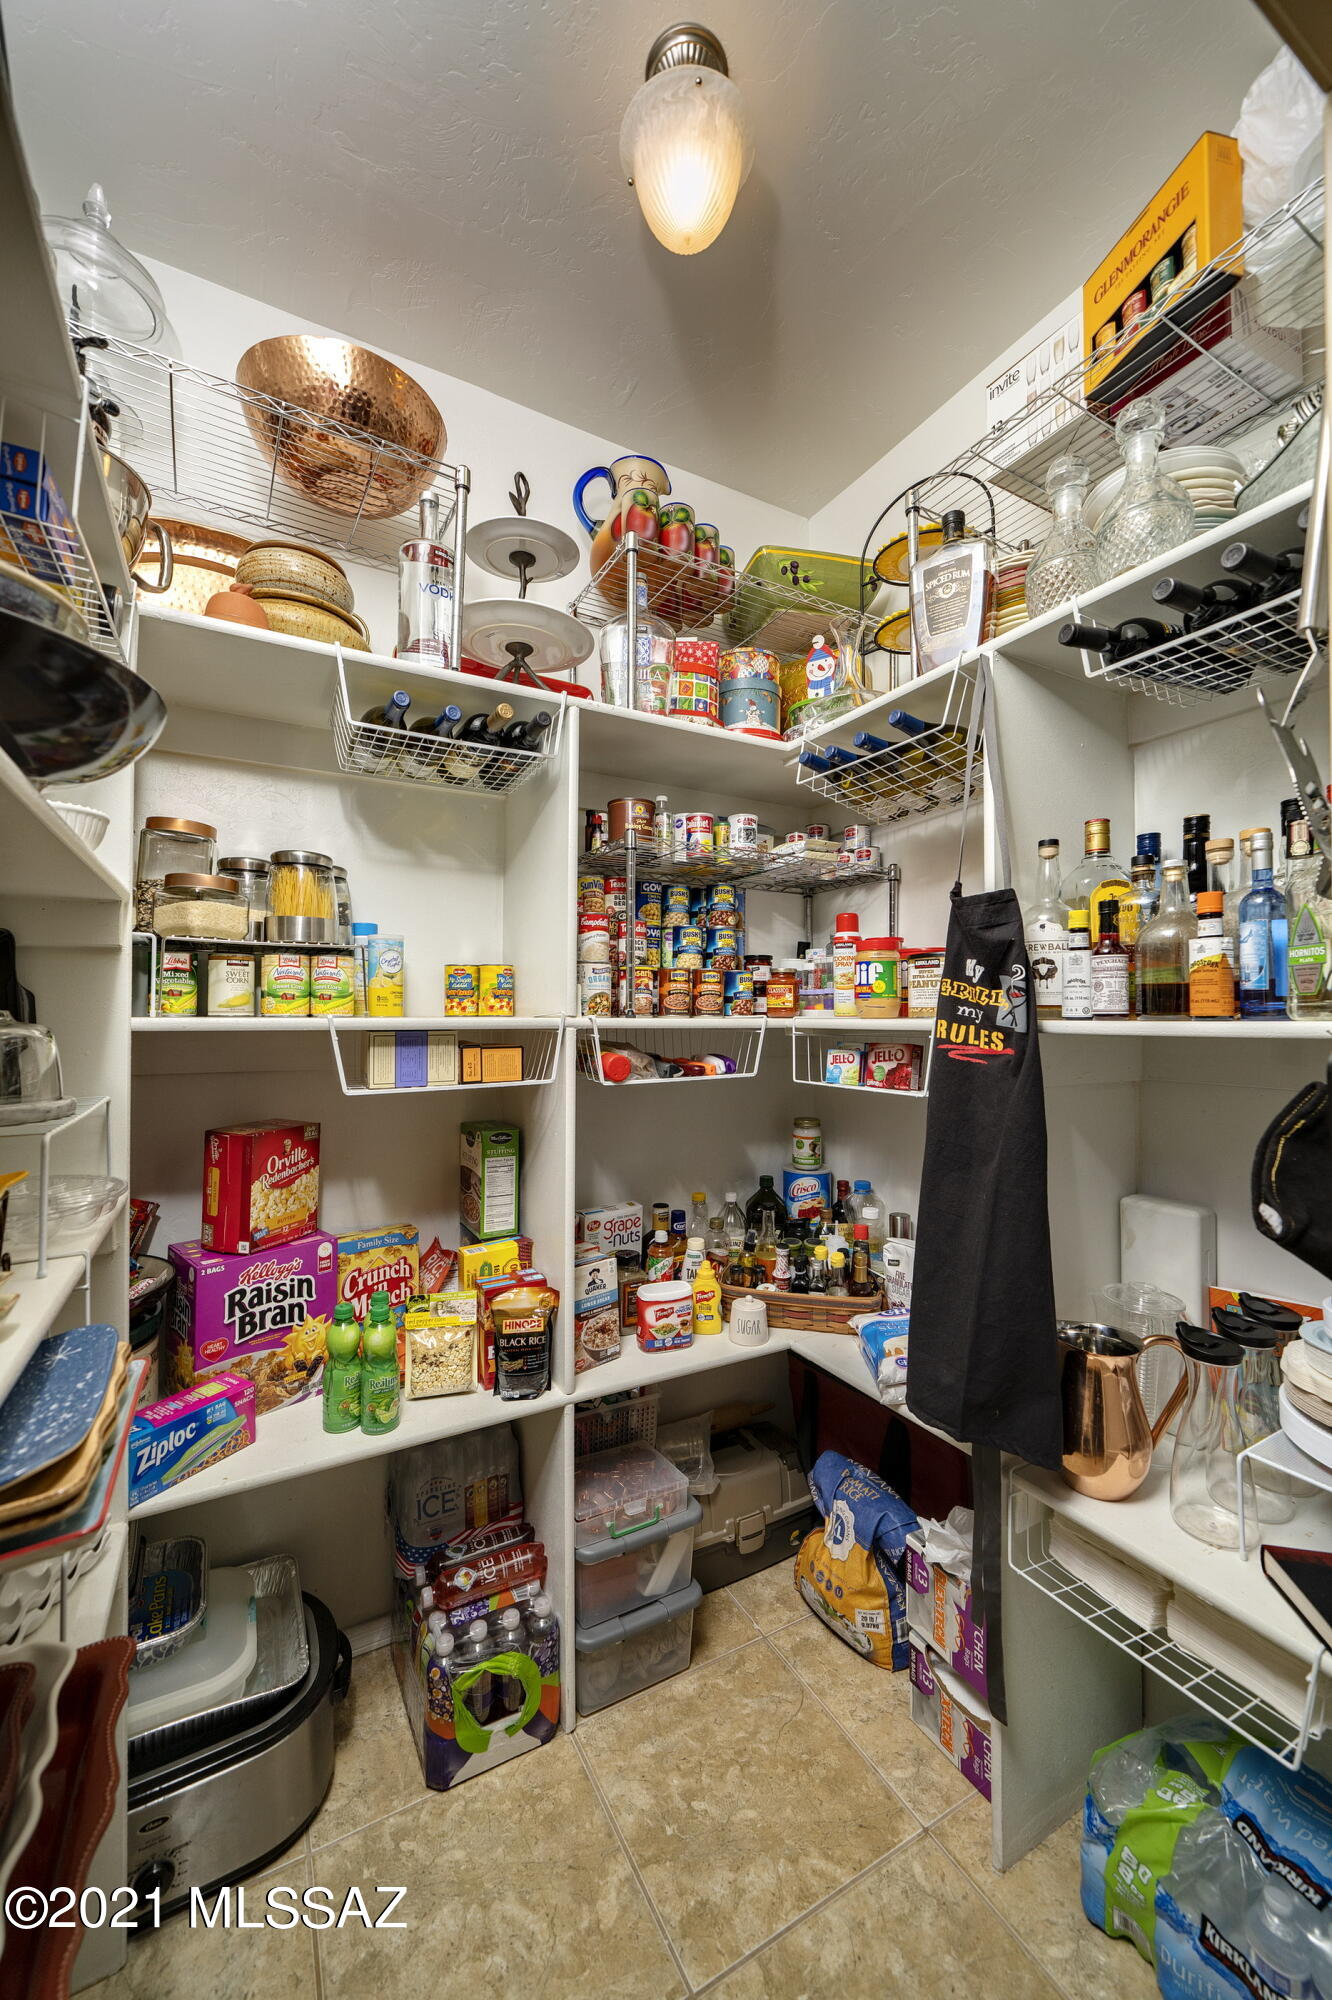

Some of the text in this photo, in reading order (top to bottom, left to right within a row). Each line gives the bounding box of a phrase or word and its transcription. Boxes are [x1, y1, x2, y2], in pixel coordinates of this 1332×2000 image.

[1093, 180, 1191, 305] GLENMORANGIE
[989, 369, 1020, 400] invite
[925, 569, 971, 592] SPICED RUM
[642, 883, 661, 892] GOY
[1025, 943, 1069, 952] REWBALL
[1289, 946, 1326, 958] HORNITOS
[164, 956, 188, 965] Libby's
[381, 955, 399, 965] Crystal
[162, 970, 189, 978] Mixed
[272, 967, 304, 976] Naturals
[314, 968, 342, 976] Naturals
[856, 962, 884, 984] Jif
[965, 958, 985, 984] My
[957, 1005, 984, 1024] my
[936, 1019, 1006, 1052] RULES
[872, 1048, 905, 1065] JELL-O
[267, 1146, 308, 1175] Orville
[259, 1156, 315, 1190] Redenbacher's
[791, 1183, 818, 1198] Crisco
[603, 1216, 641, 1240] grape
[357, 1236, 400, 1250] Family Size
[608, 1230, 641, 1247] -nuts
[206, 1265, 225, 1274] BAGS
[238, 1257, 304, 1286] Kellogg's
[342, 1257, 412, 1300] Crunch
[895, 1270, 906, 1281] FINE
[584, 1283, 607, 1295] QUAKER
[225, 1276, 315, 1322] Raisin
[350, 1283, 412, 1319] Mch
[235, 1301, 307, 1343] Bran
[655, 1308, 674, 1318] French's
[504, 1319, 542, 1330] HINODE
[736, 1318, 761, 1336] SUGAR
[204, 1345, 226, 1354] HEALTHY
[499, 1335, 547, 1347] BLACK RICE
[234, 1394, 255, 1408] SNACK
[244, 1387, 255, 1396] 120
[136, 1422, 197, 1477] Ziploc
[840, 1481, 864, 1502] RICE
[416, 1489, 457, 1521] ICE
[484, 1557, 497, 1584] ICE
[918, 1567, 928, 1588] 13
[148, 1575, 168, 1611] Pans
[973, 1624, 985, 1674] TCHEN
[921, 1667, 934, 1690] 13
